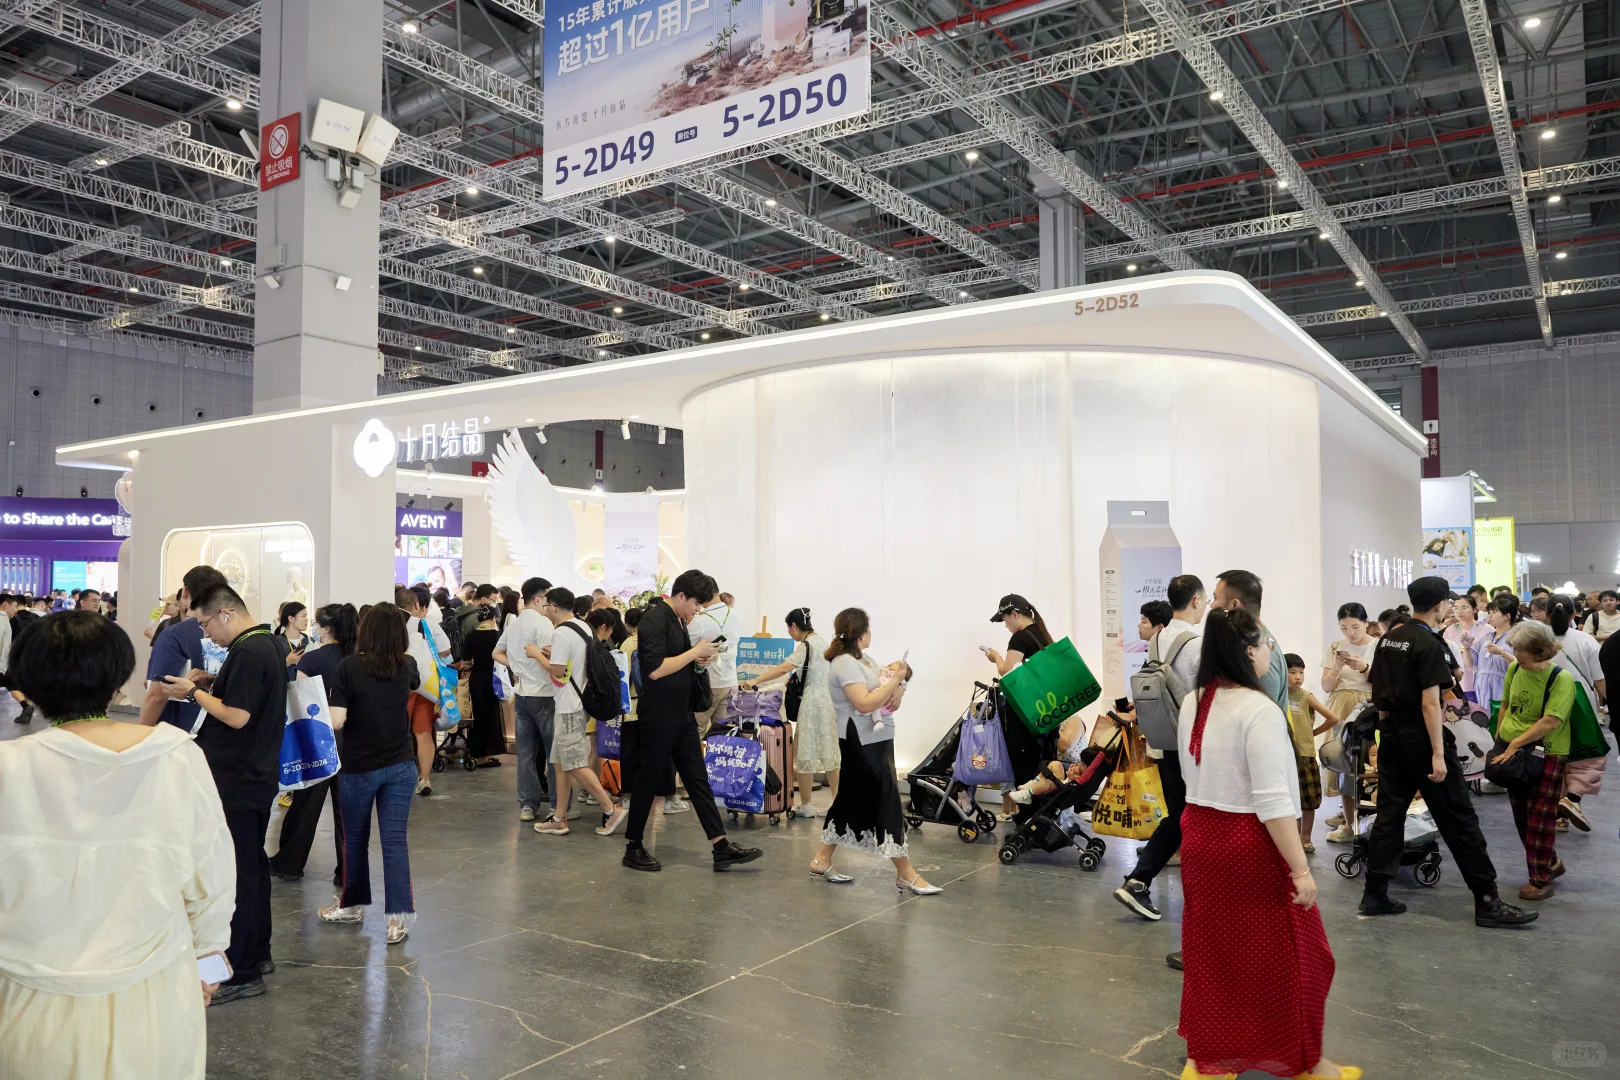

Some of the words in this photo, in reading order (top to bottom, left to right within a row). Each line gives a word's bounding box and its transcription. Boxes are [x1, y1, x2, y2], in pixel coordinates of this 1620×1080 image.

[557, 0, 711, 76] 超过1亿用户
[722, 72, 848, 138] 5-2D50
[265, 156, 293, 177] 禁止吸烟
[555, 130, 655, 186] 5-2D49
[1074, 292, 1140, 316] 5-2D52
[400, 417, 482, 463] 十月结晶
[3, 512, 21, 525] to
[22, 512, 64, 526] Share
[66, 512, 90, 526] the
[400, 513, 447, 529] AVENT
[1033, 682, 1102, 729] KOCOTREE
